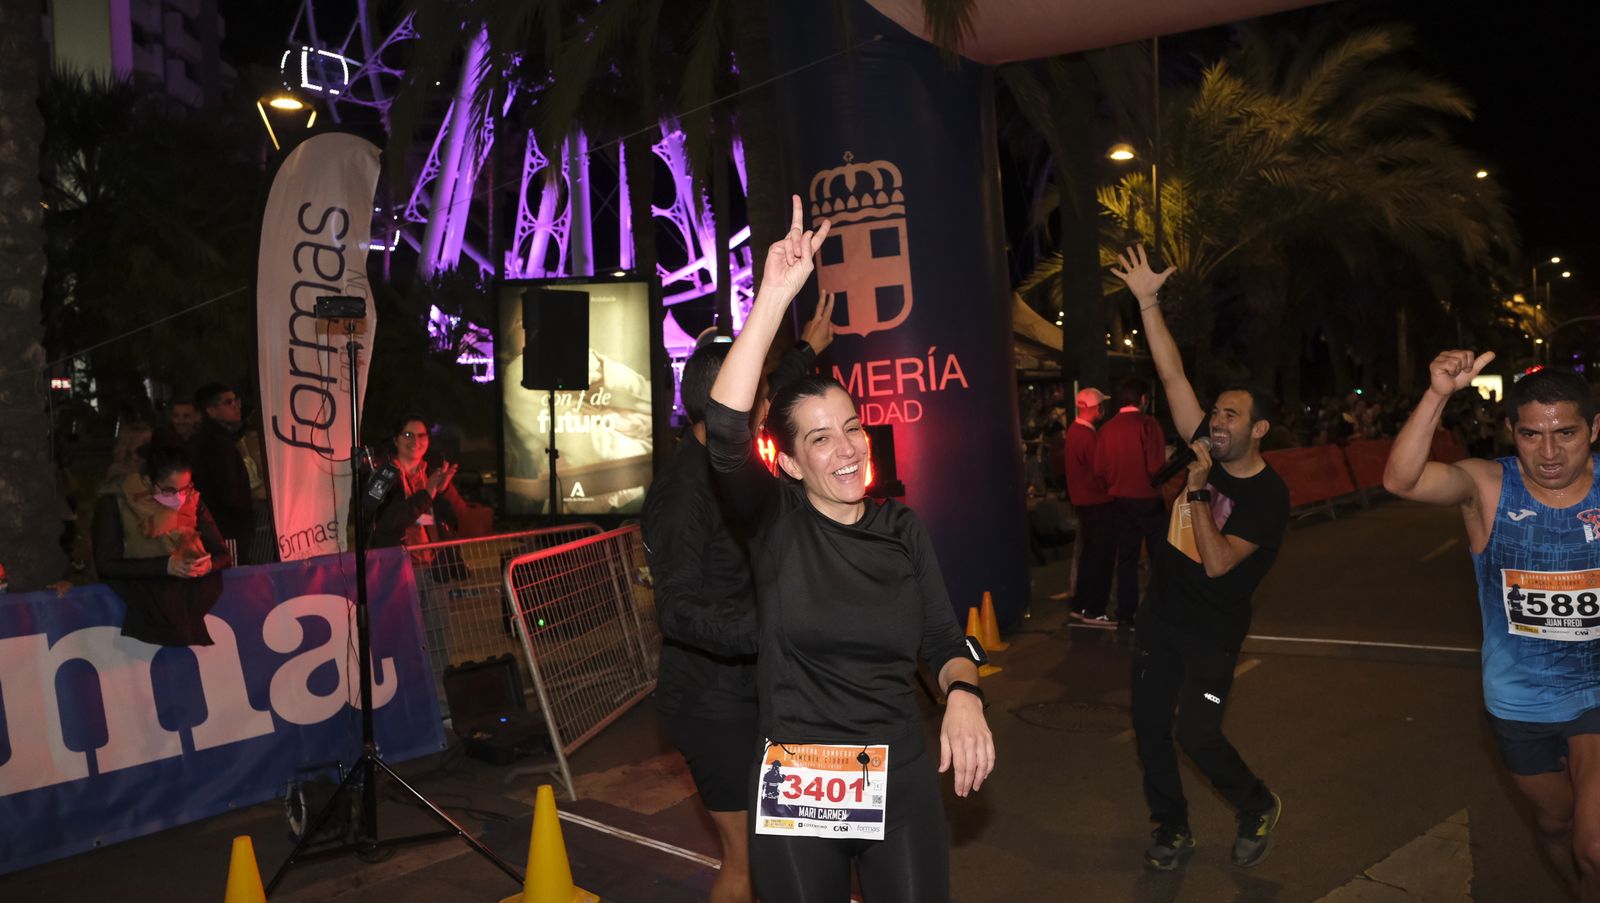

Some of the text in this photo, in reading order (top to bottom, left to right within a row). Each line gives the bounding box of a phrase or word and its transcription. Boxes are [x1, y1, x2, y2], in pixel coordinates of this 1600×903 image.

[271, 201, 350, 455] formas
[831, 345, 969, 398] MERÍA
[590, 387, 612, 406] de
[537, 408, 617, 434] futuro
[1544, 618, 1582, 627] JUAN FREDI
[782, 774, 865, 803] 3401
[798, 806, 848, 821] MARI CARMEN
